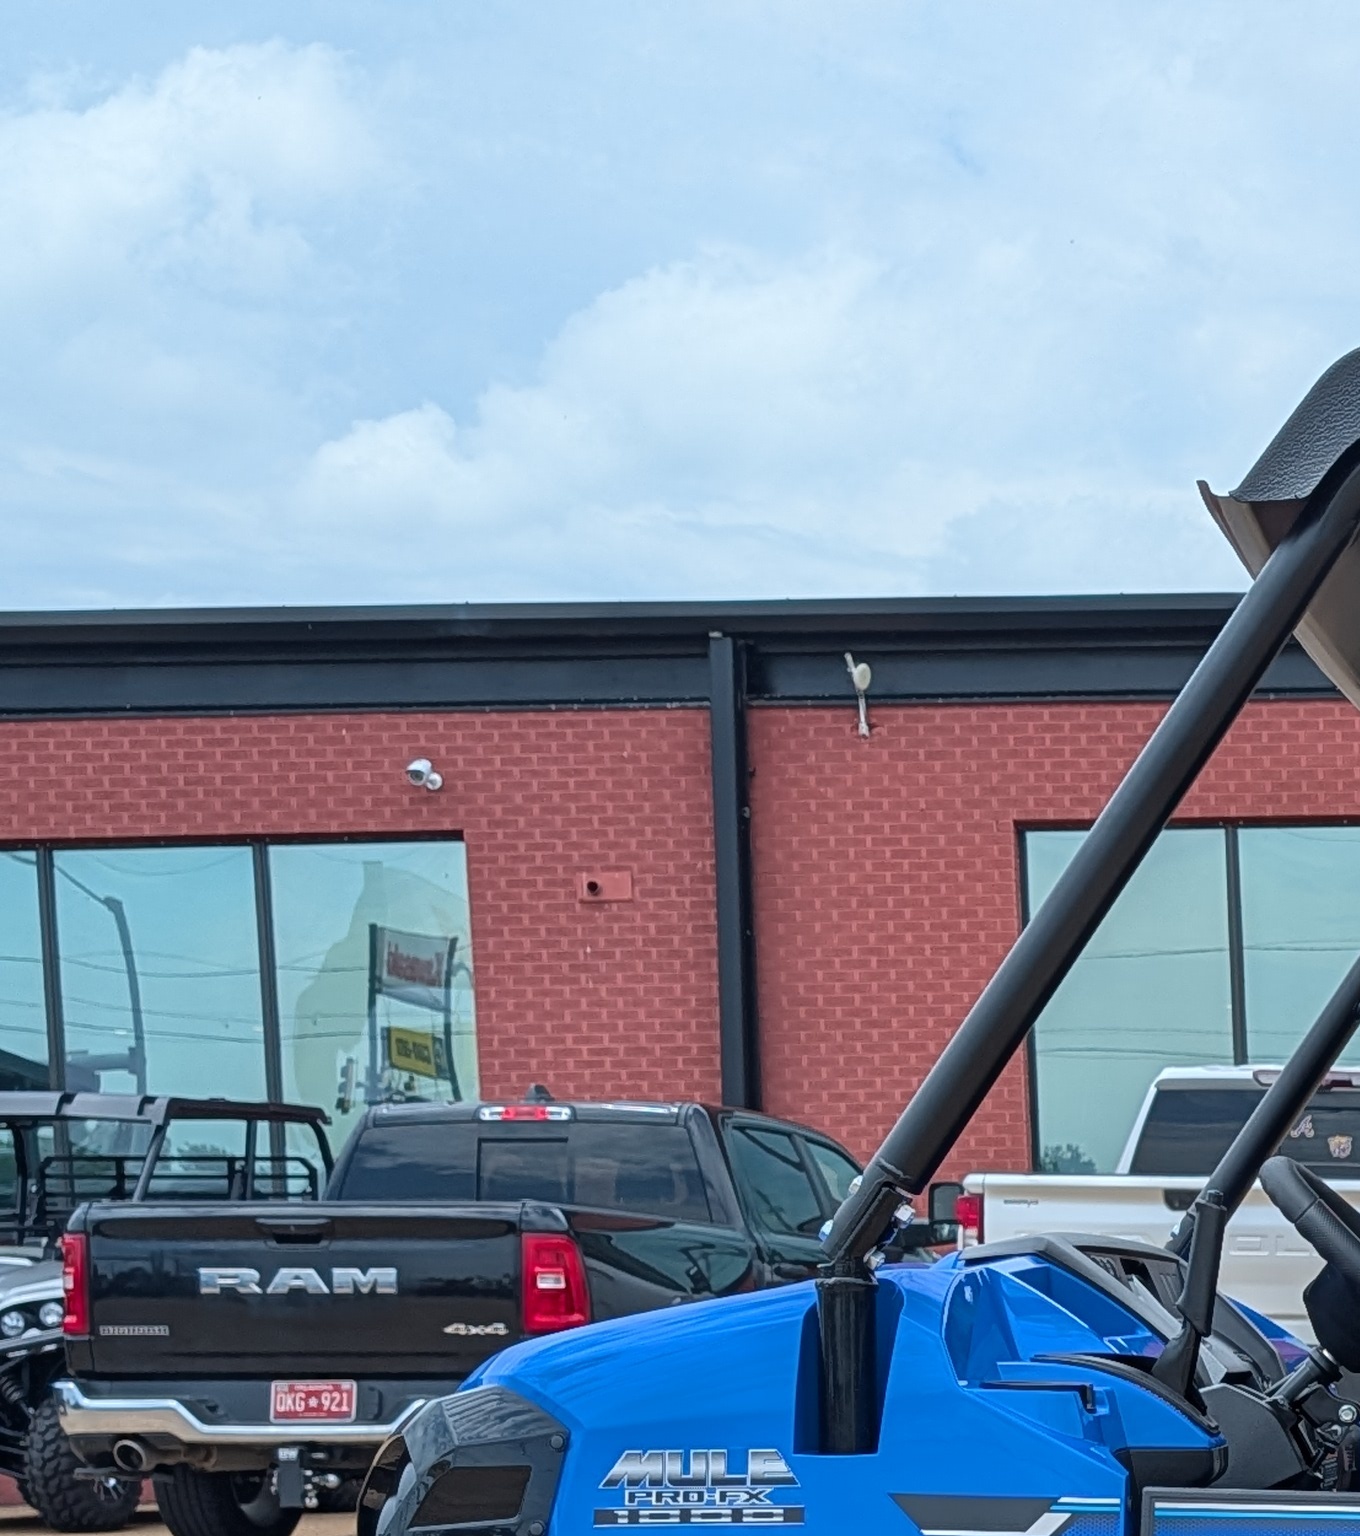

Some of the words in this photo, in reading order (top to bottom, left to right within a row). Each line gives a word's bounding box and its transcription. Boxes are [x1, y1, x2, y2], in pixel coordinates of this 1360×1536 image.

[198, 1267, 398, 1294] RAM
[321, 1391, 351, 1412] 921
[598, 1448, 801, 1488] MULE
[625, 1488, 774, 1506] PRO-FX
[613, 1508, 785, 1524] 1000
